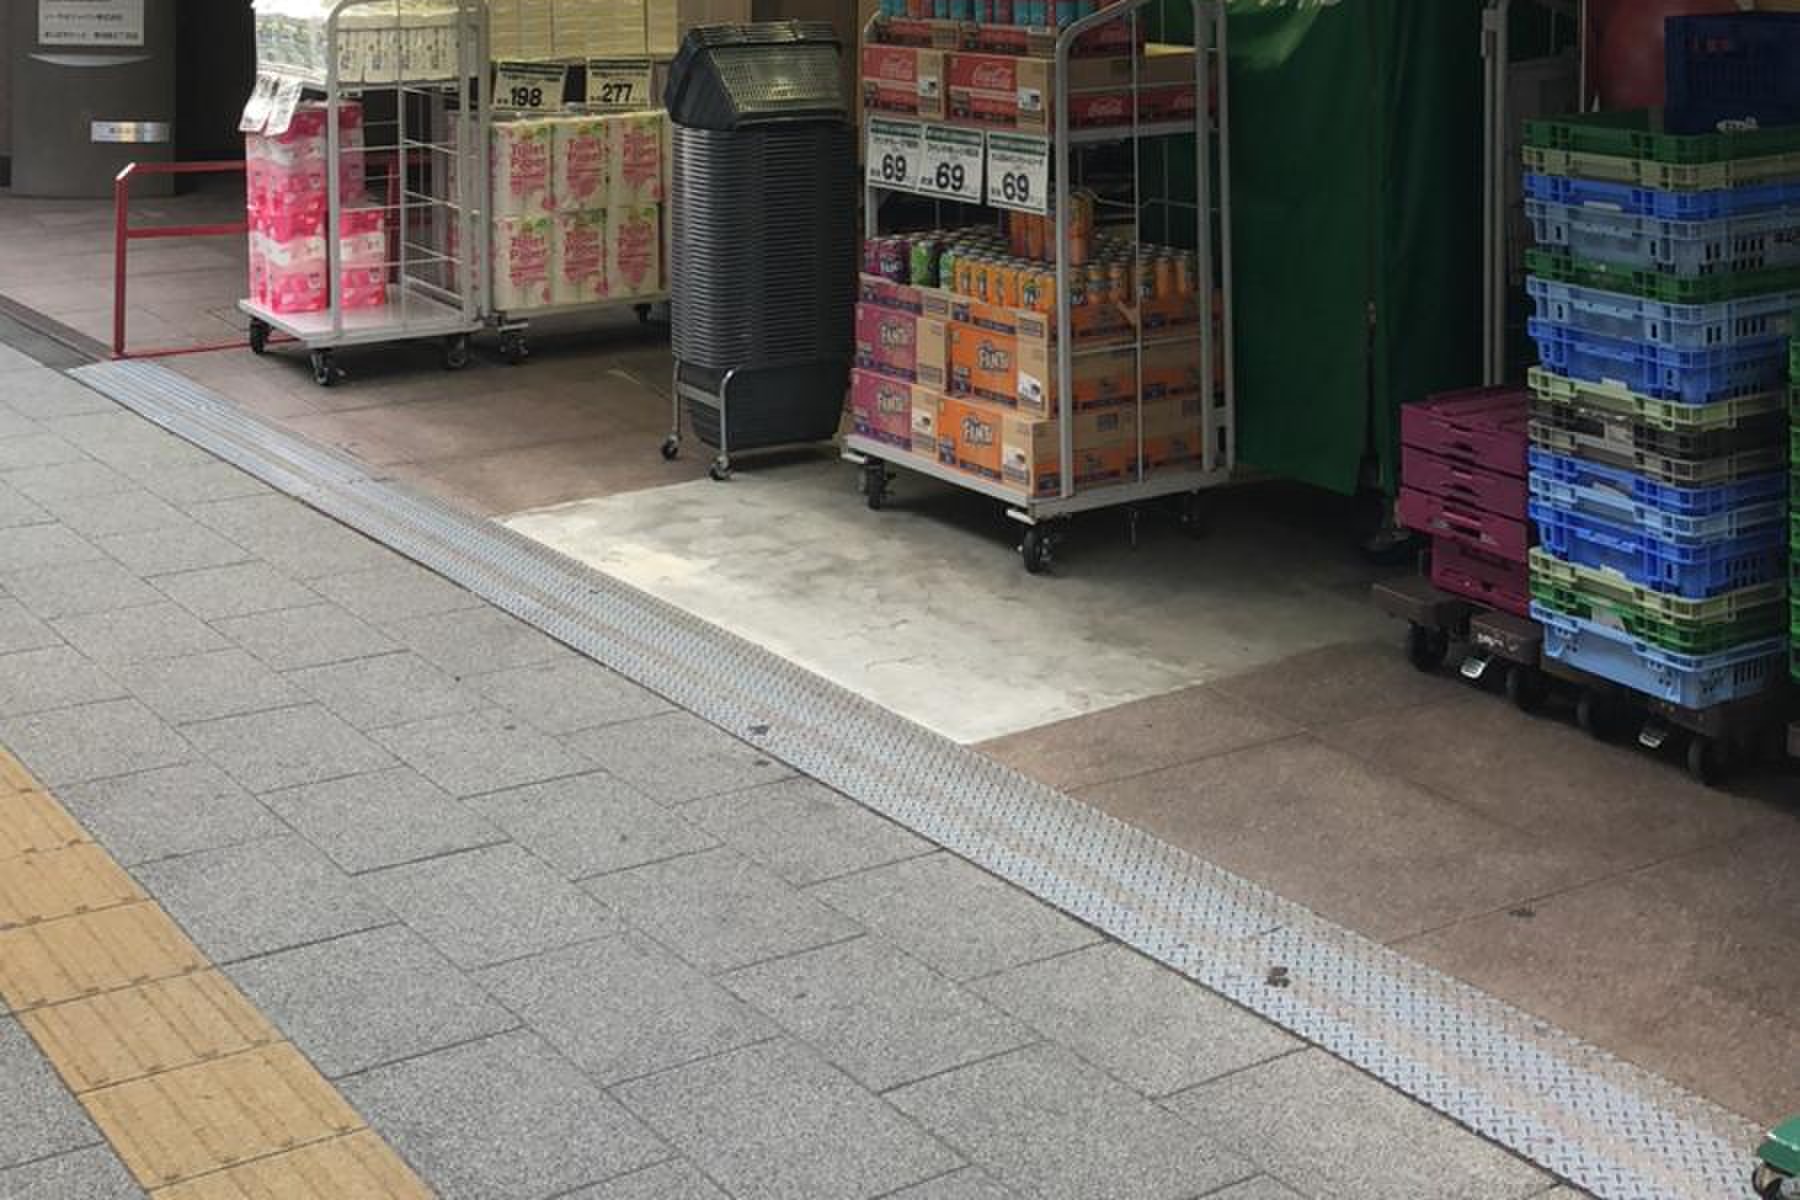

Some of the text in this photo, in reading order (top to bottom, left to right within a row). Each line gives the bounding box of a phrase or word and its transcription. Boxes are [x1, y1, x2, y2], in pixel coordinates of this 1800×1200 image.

[510, 87, 543, 107] 198
[602, 83, 634, 103] 277
[881, 153, 908, 182] 69
[935, 162, 965, 191] 69
[1002, 171, 1030, 202] 69
